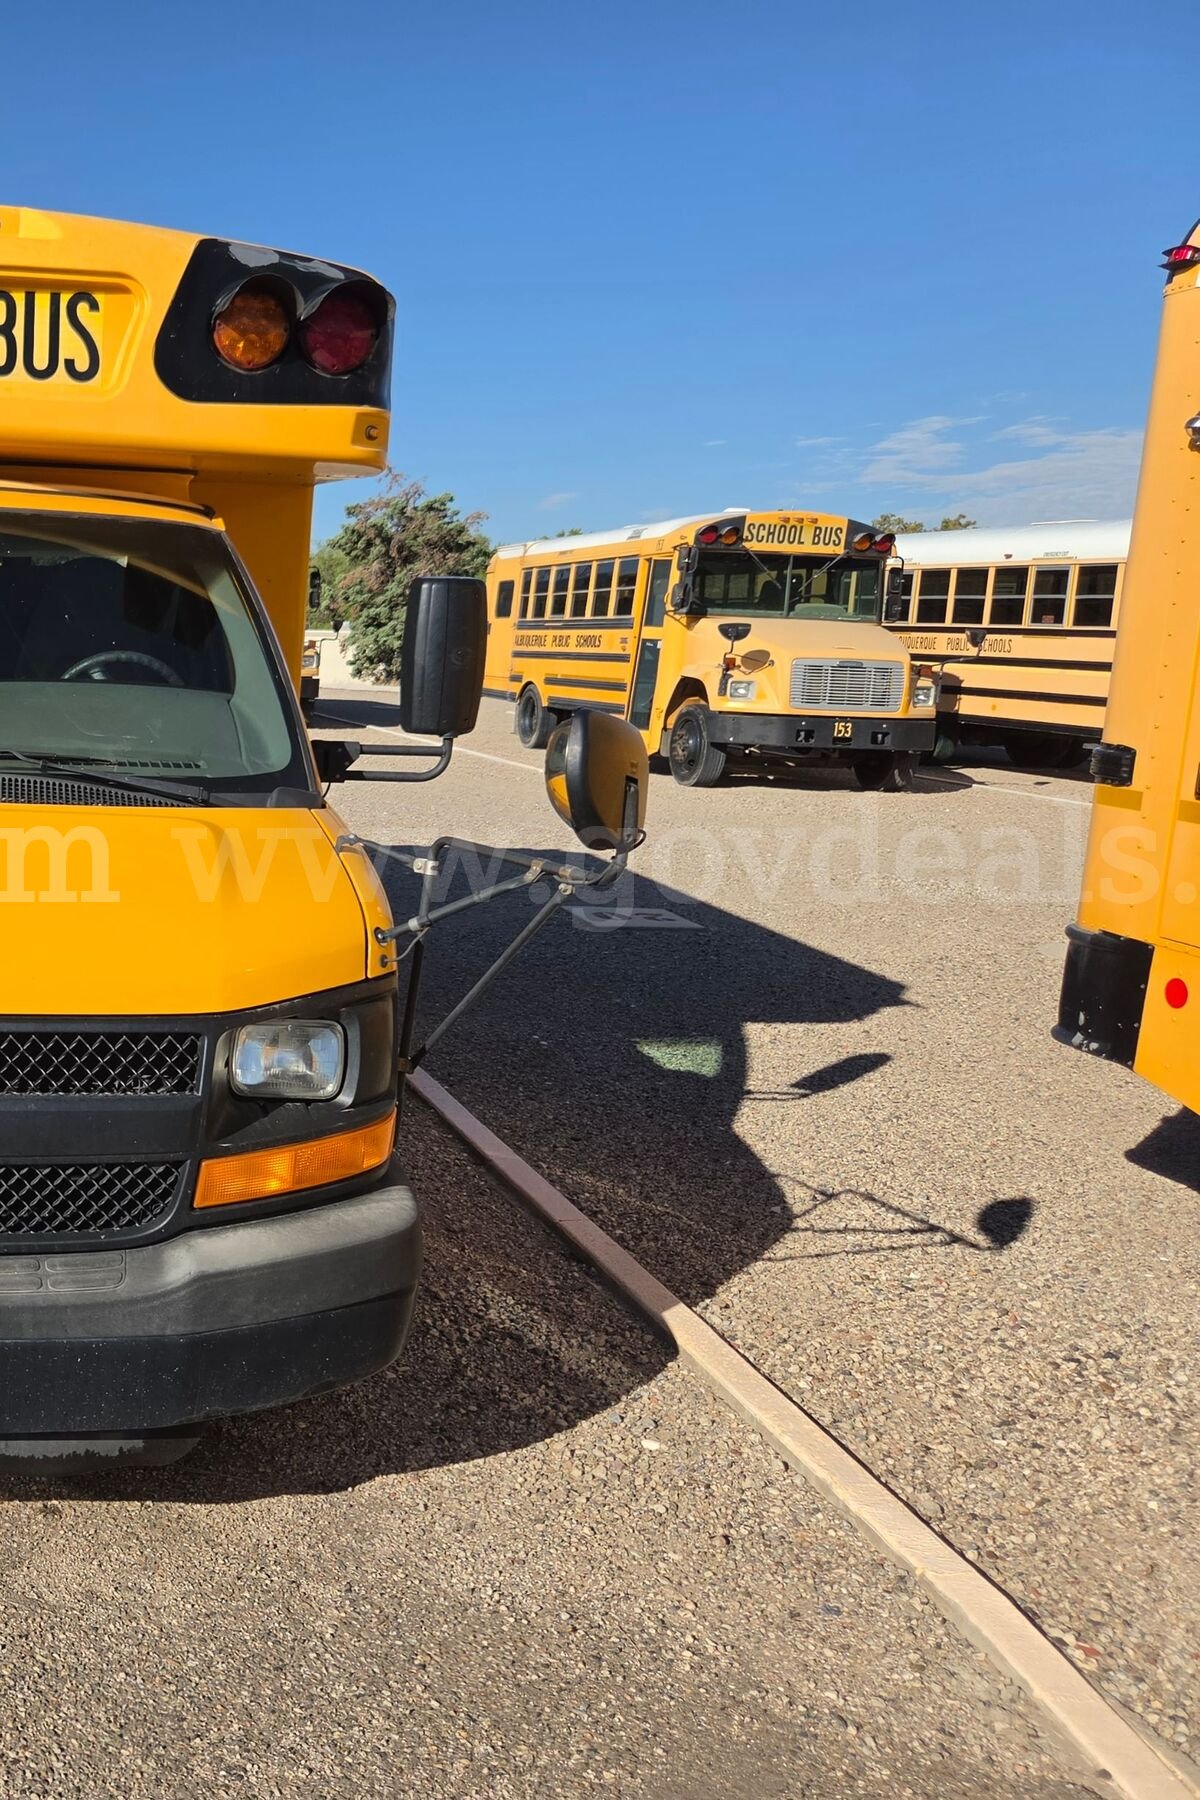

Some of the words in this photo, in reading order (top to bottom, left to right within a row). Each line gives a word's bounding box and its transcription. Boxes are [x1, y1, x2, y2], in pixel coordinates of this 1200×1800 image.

[746, 522, 805, 545] SCHOOL
[812, 523, 843, 547] BUS
[551, 635, 571, 648] PUBLIC
[575, 634, 602, 648] SCHOOLS
[833, 722, 853, 738] 153
